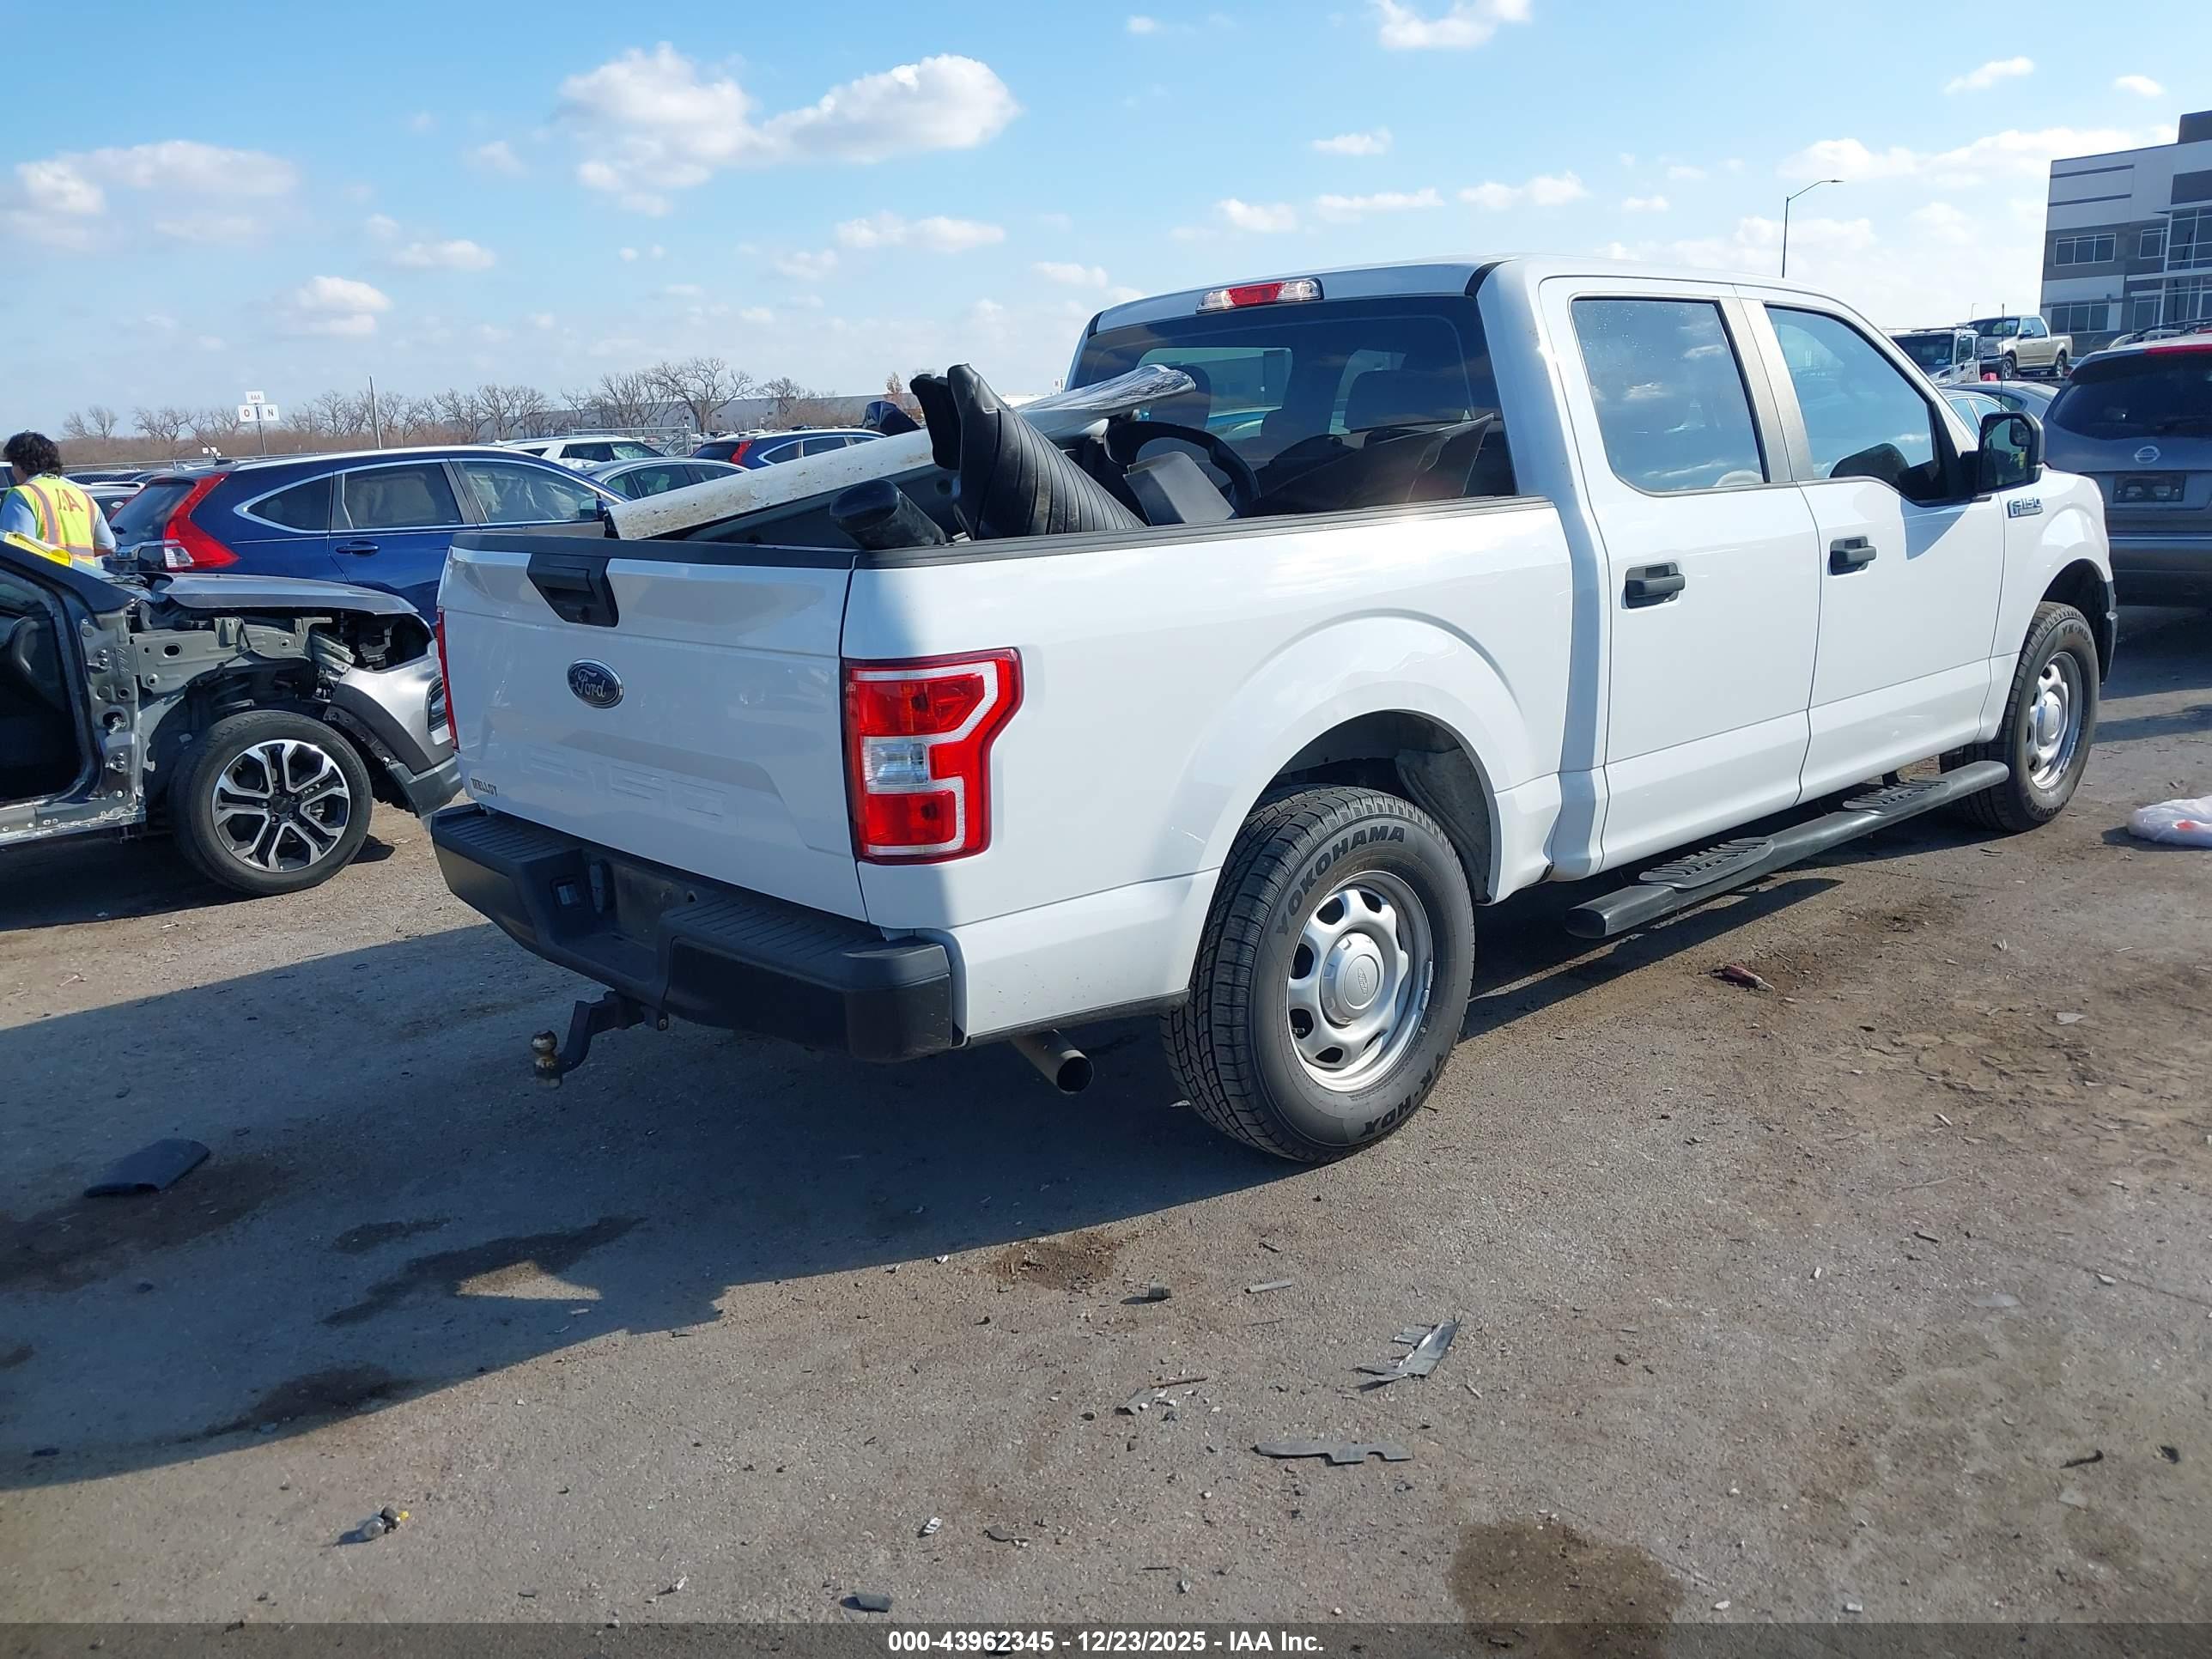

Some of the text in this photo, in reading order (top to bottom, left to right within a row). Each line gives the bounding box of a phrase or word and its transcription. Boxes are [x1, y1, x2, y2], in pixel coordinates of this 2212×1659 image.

[267, 408, 275, 417] N
[576, 668, 606, 698] Ford
[1275, 825, 1406, 935] YOKOHAMA
